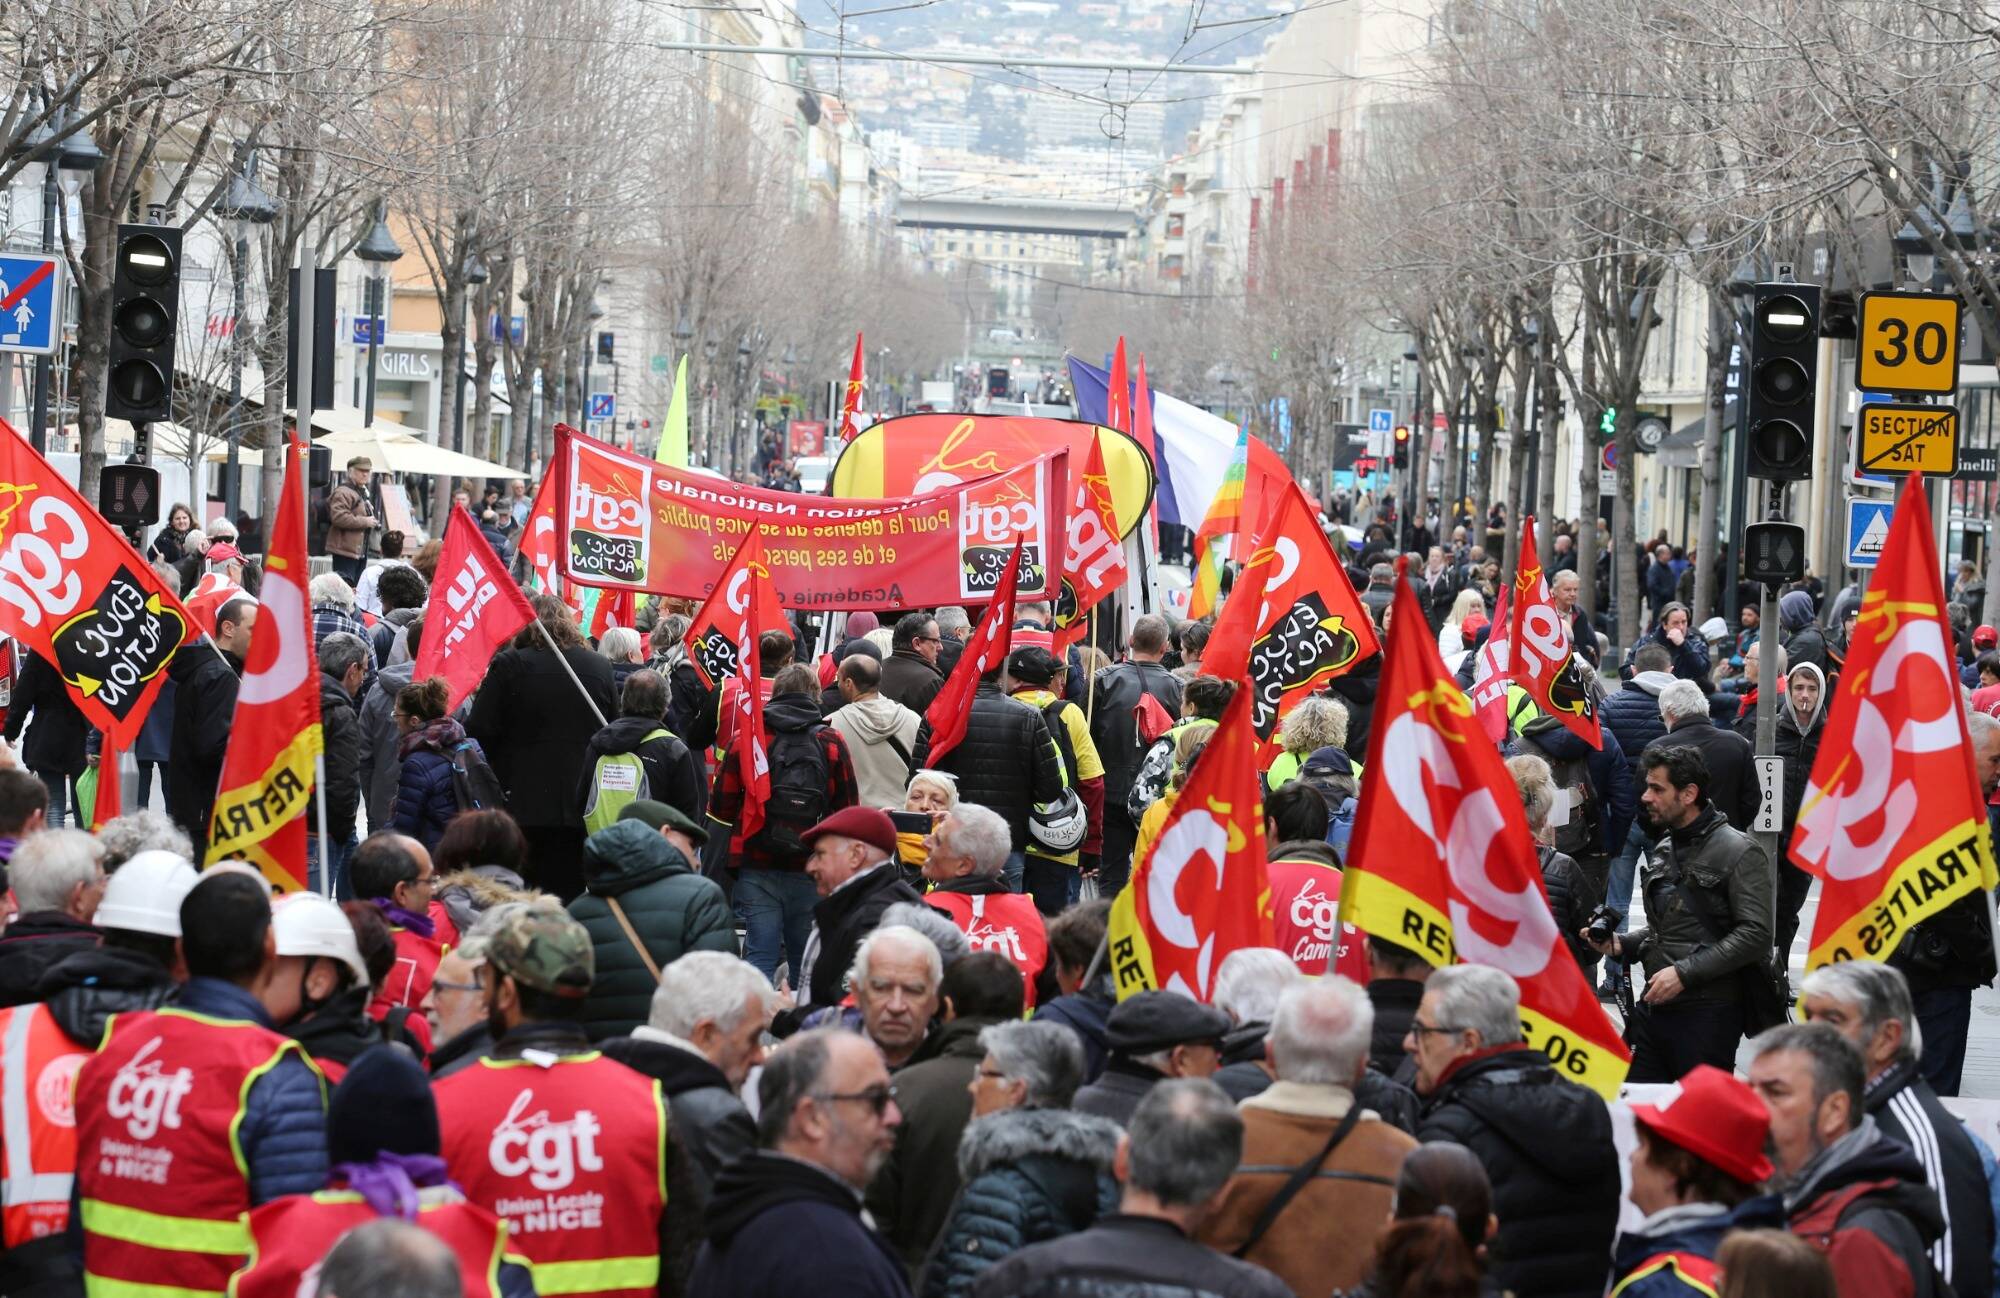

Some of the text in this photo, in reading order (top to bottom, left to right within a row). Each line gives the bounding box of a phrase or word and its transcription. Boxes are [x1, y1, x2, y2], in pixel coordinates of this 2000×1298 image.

[1874, 318, 1948, 367] 30
[381, 352, 430, 376] GIRLS
[1870, 416, 1950, 437] SECTION
[919, 418, 1002, 474] la
[1892, 443, 1925, 462] SAT
[1959, 455, 1996, 471] inelli
[1382, 712, 1560, 978] cg
[1293, 878, 1326, 901] la
[1290, 900, 1356, 941] cg
[1293, 935, 1349, 962] Canns
[117, 1036, 163, 1076] la
[1543, 1036, 1589, 1076] 06
[107, 1067, 193, 1140] cgt
[492, 1088, 549, 1136] la
[488, 1110, 604, 1191] cgt
[115, 1158, 168, 1185] NICE
[496, 1190, 604, 1216] Union Locale
[523, 1208, 602, 1233] NICE
